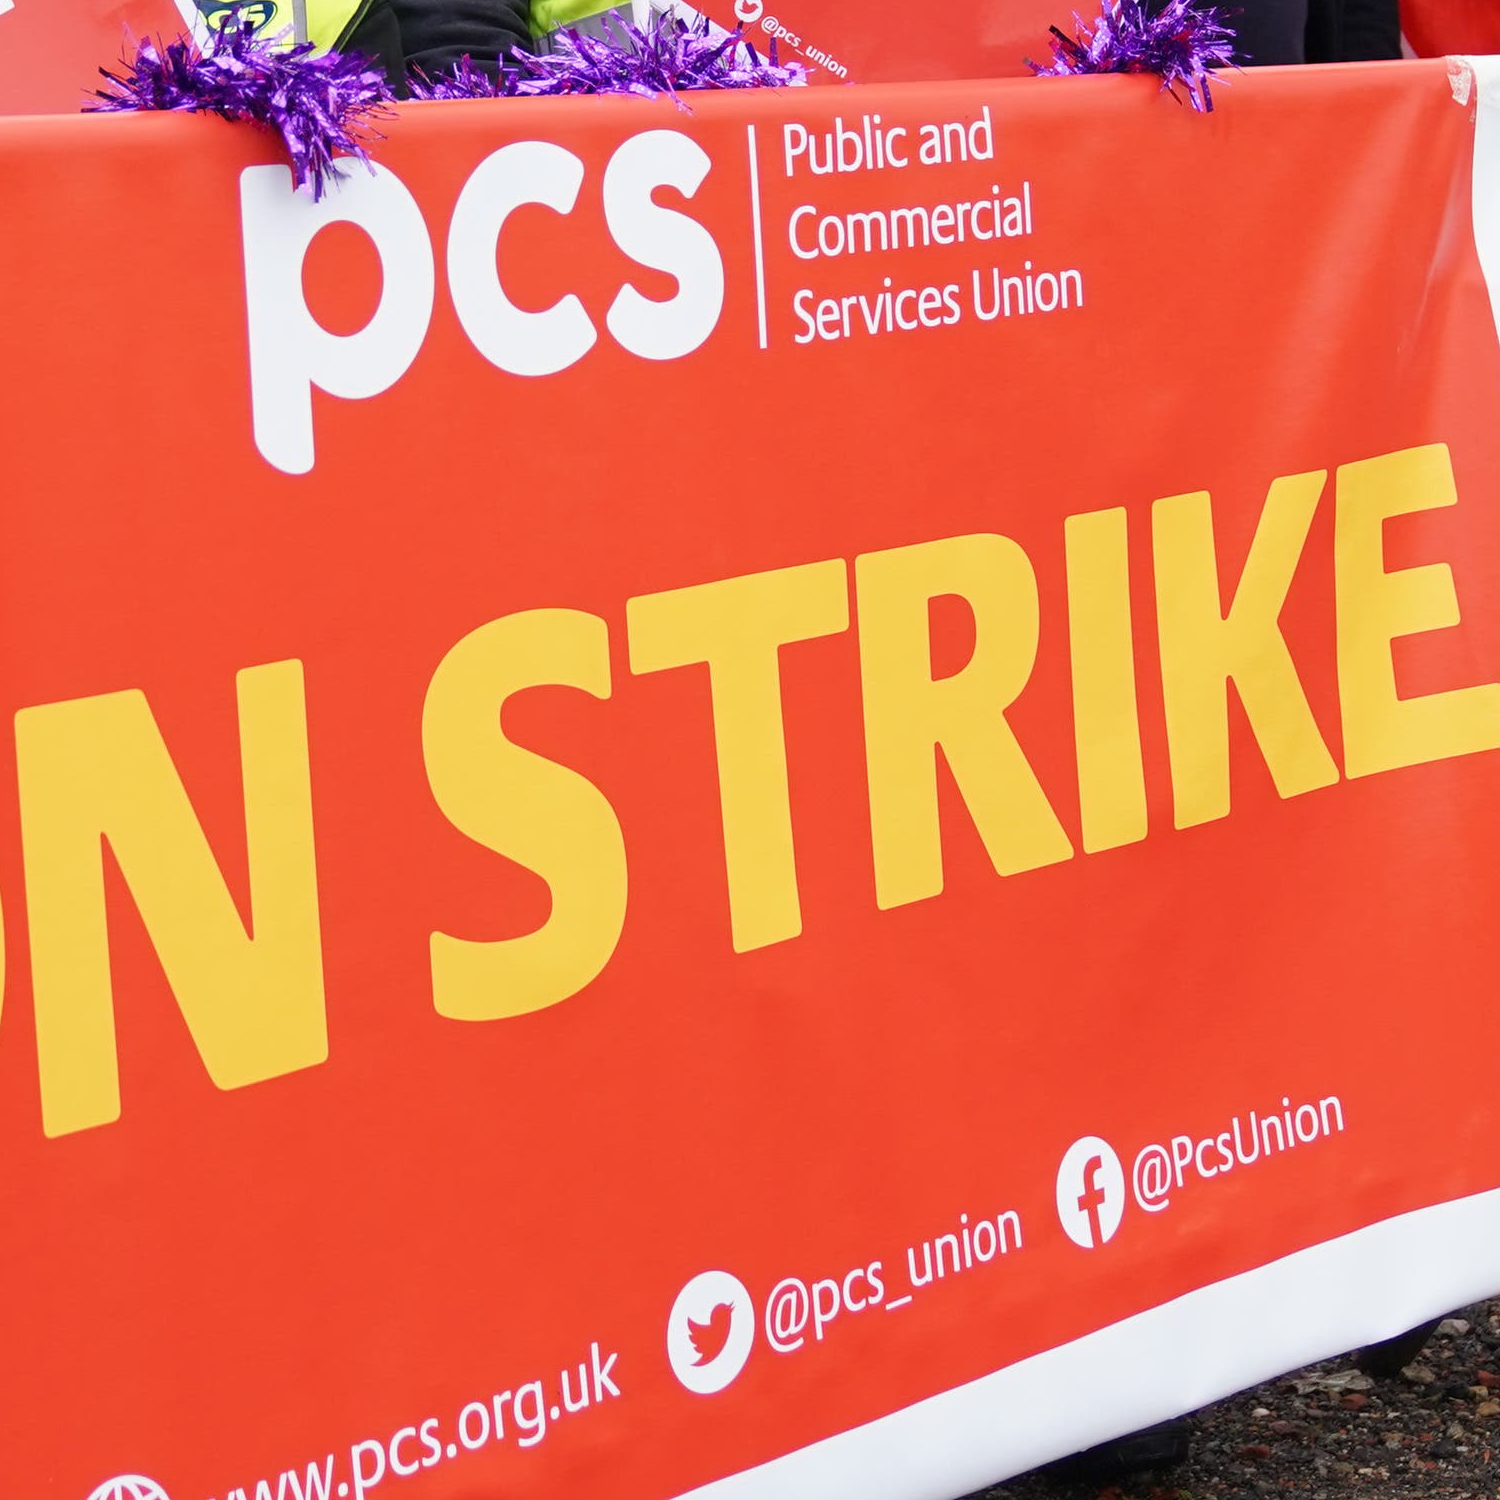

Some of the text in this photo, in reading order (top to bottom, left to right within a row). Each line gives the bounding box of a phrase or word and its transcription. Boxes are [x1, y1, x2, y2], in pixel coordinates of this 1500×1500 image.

[761, 16, 847, 78] @pcs_union
[784, 106, 994, 176] Public and
[789, 182, 1032, 259] Commercial
[240, 130, 724, 474] pcs
[794, 261, 1083, 344] Services Union
[1132, 1096, 1344, 1211] @PcsUnion
[765, 1210, 1022, 1353] @pcs_union
[206, 1342, 621, 1500] w.pcs.org.uk
